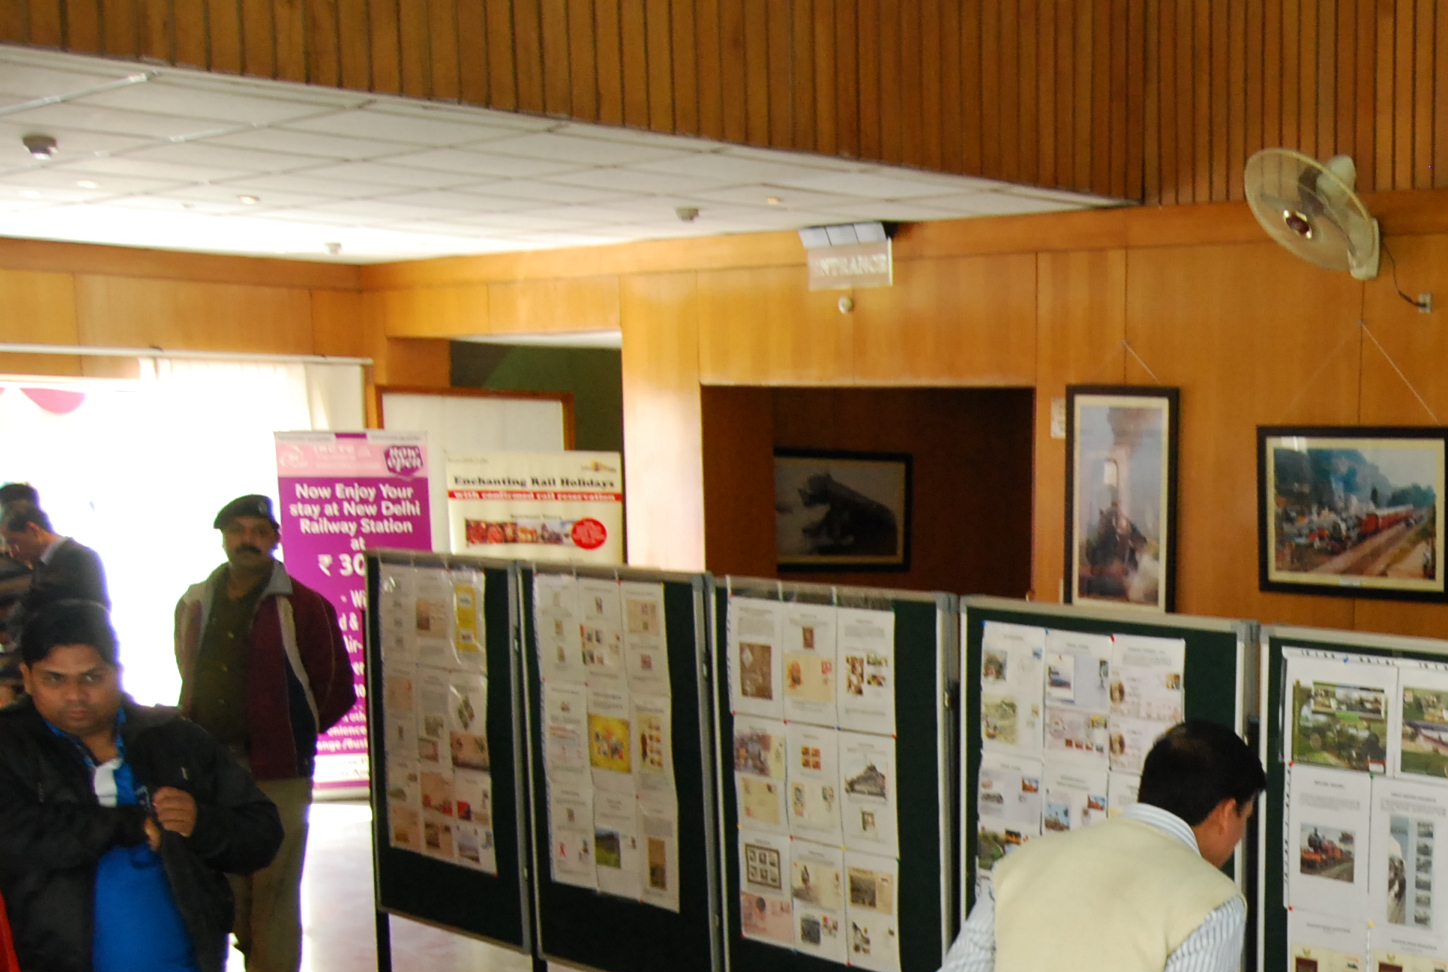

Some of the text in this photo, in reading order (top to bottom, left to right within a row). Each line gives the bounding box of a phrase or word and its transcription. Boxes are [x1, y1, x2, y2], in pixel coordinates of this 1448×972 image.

[814, 253, 888, 277] NTRANCE
[295, 482, 414, 503] Now Enjoy Your
[454, 476, 615, 490] Enchanting Rail Holidays
[289, 500, 421, 519] stay at New Delhi
[300, 518, 413, 537] Railway Station
[351, 537, 366, 551] at
